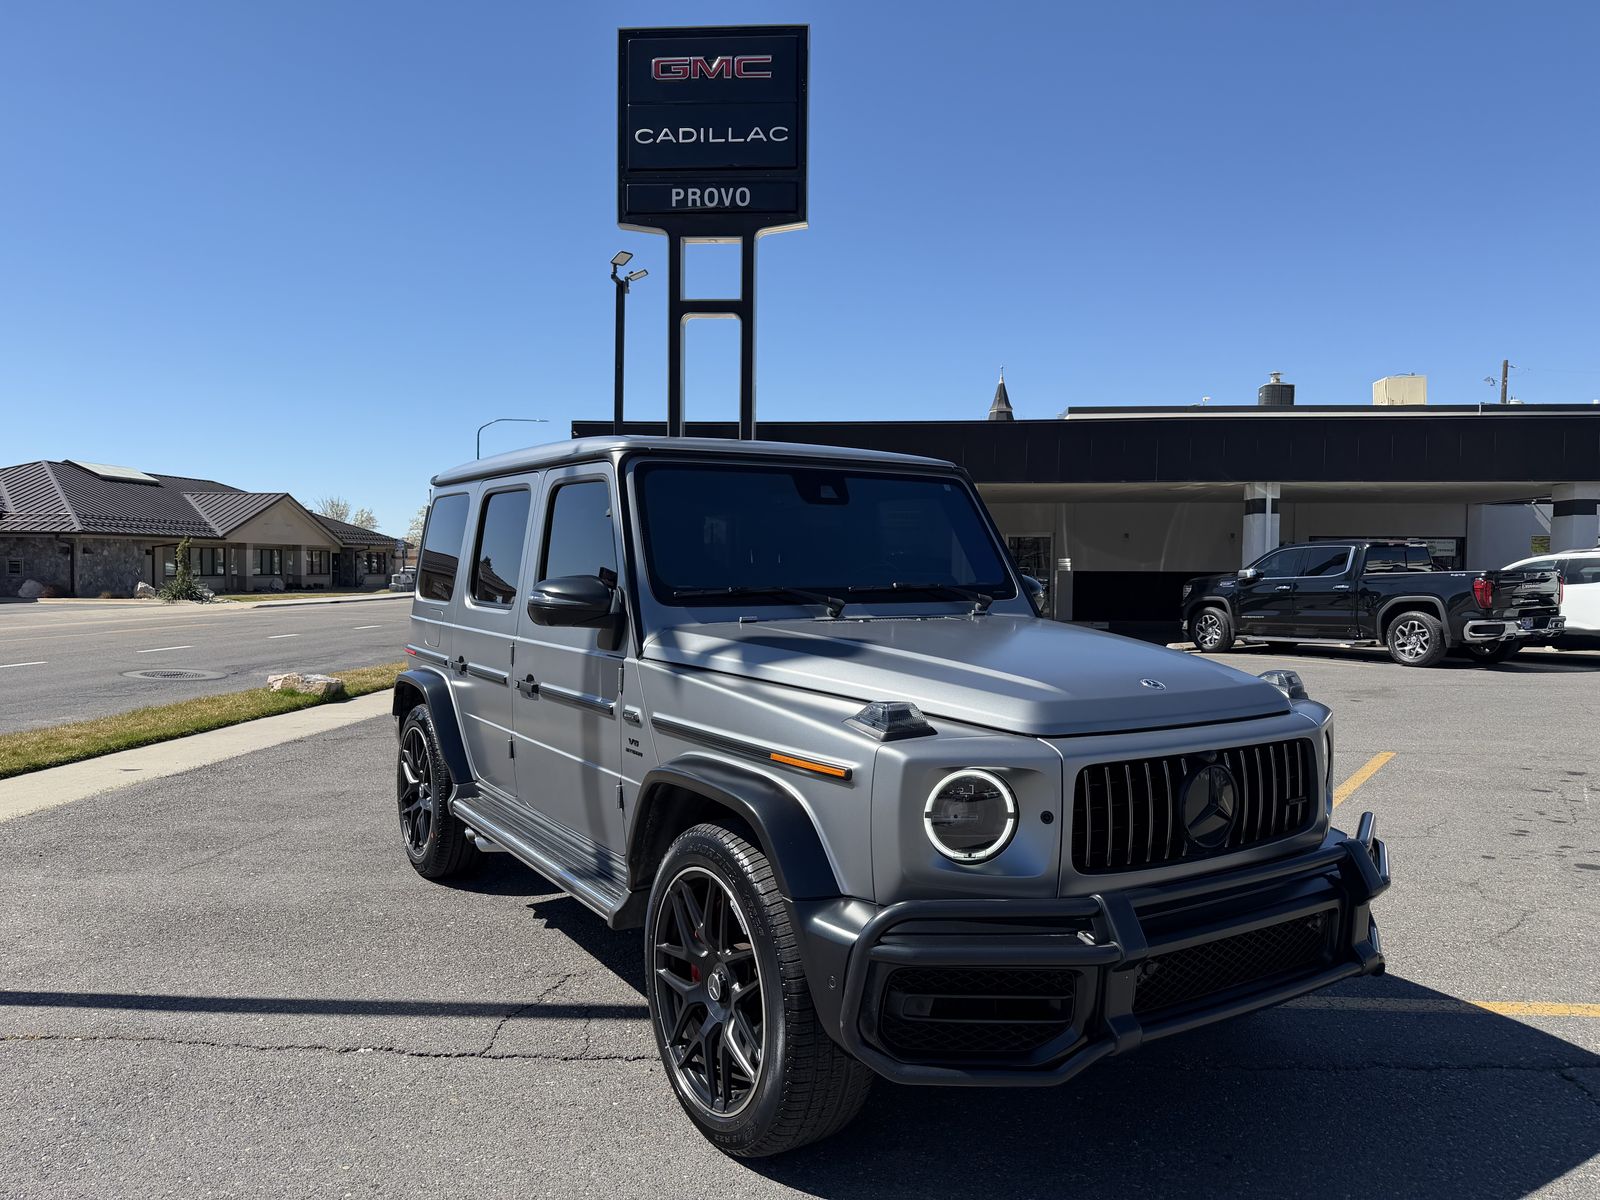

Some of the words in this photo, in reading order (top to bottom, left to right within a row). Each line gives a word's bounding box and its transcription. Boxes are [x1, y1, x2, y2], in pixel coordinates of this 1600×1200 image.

[652, 55, 772, 80] GMC
[634, 126, 789, 144] CADILLAC
[671, 187, 751, 207] PROVO
